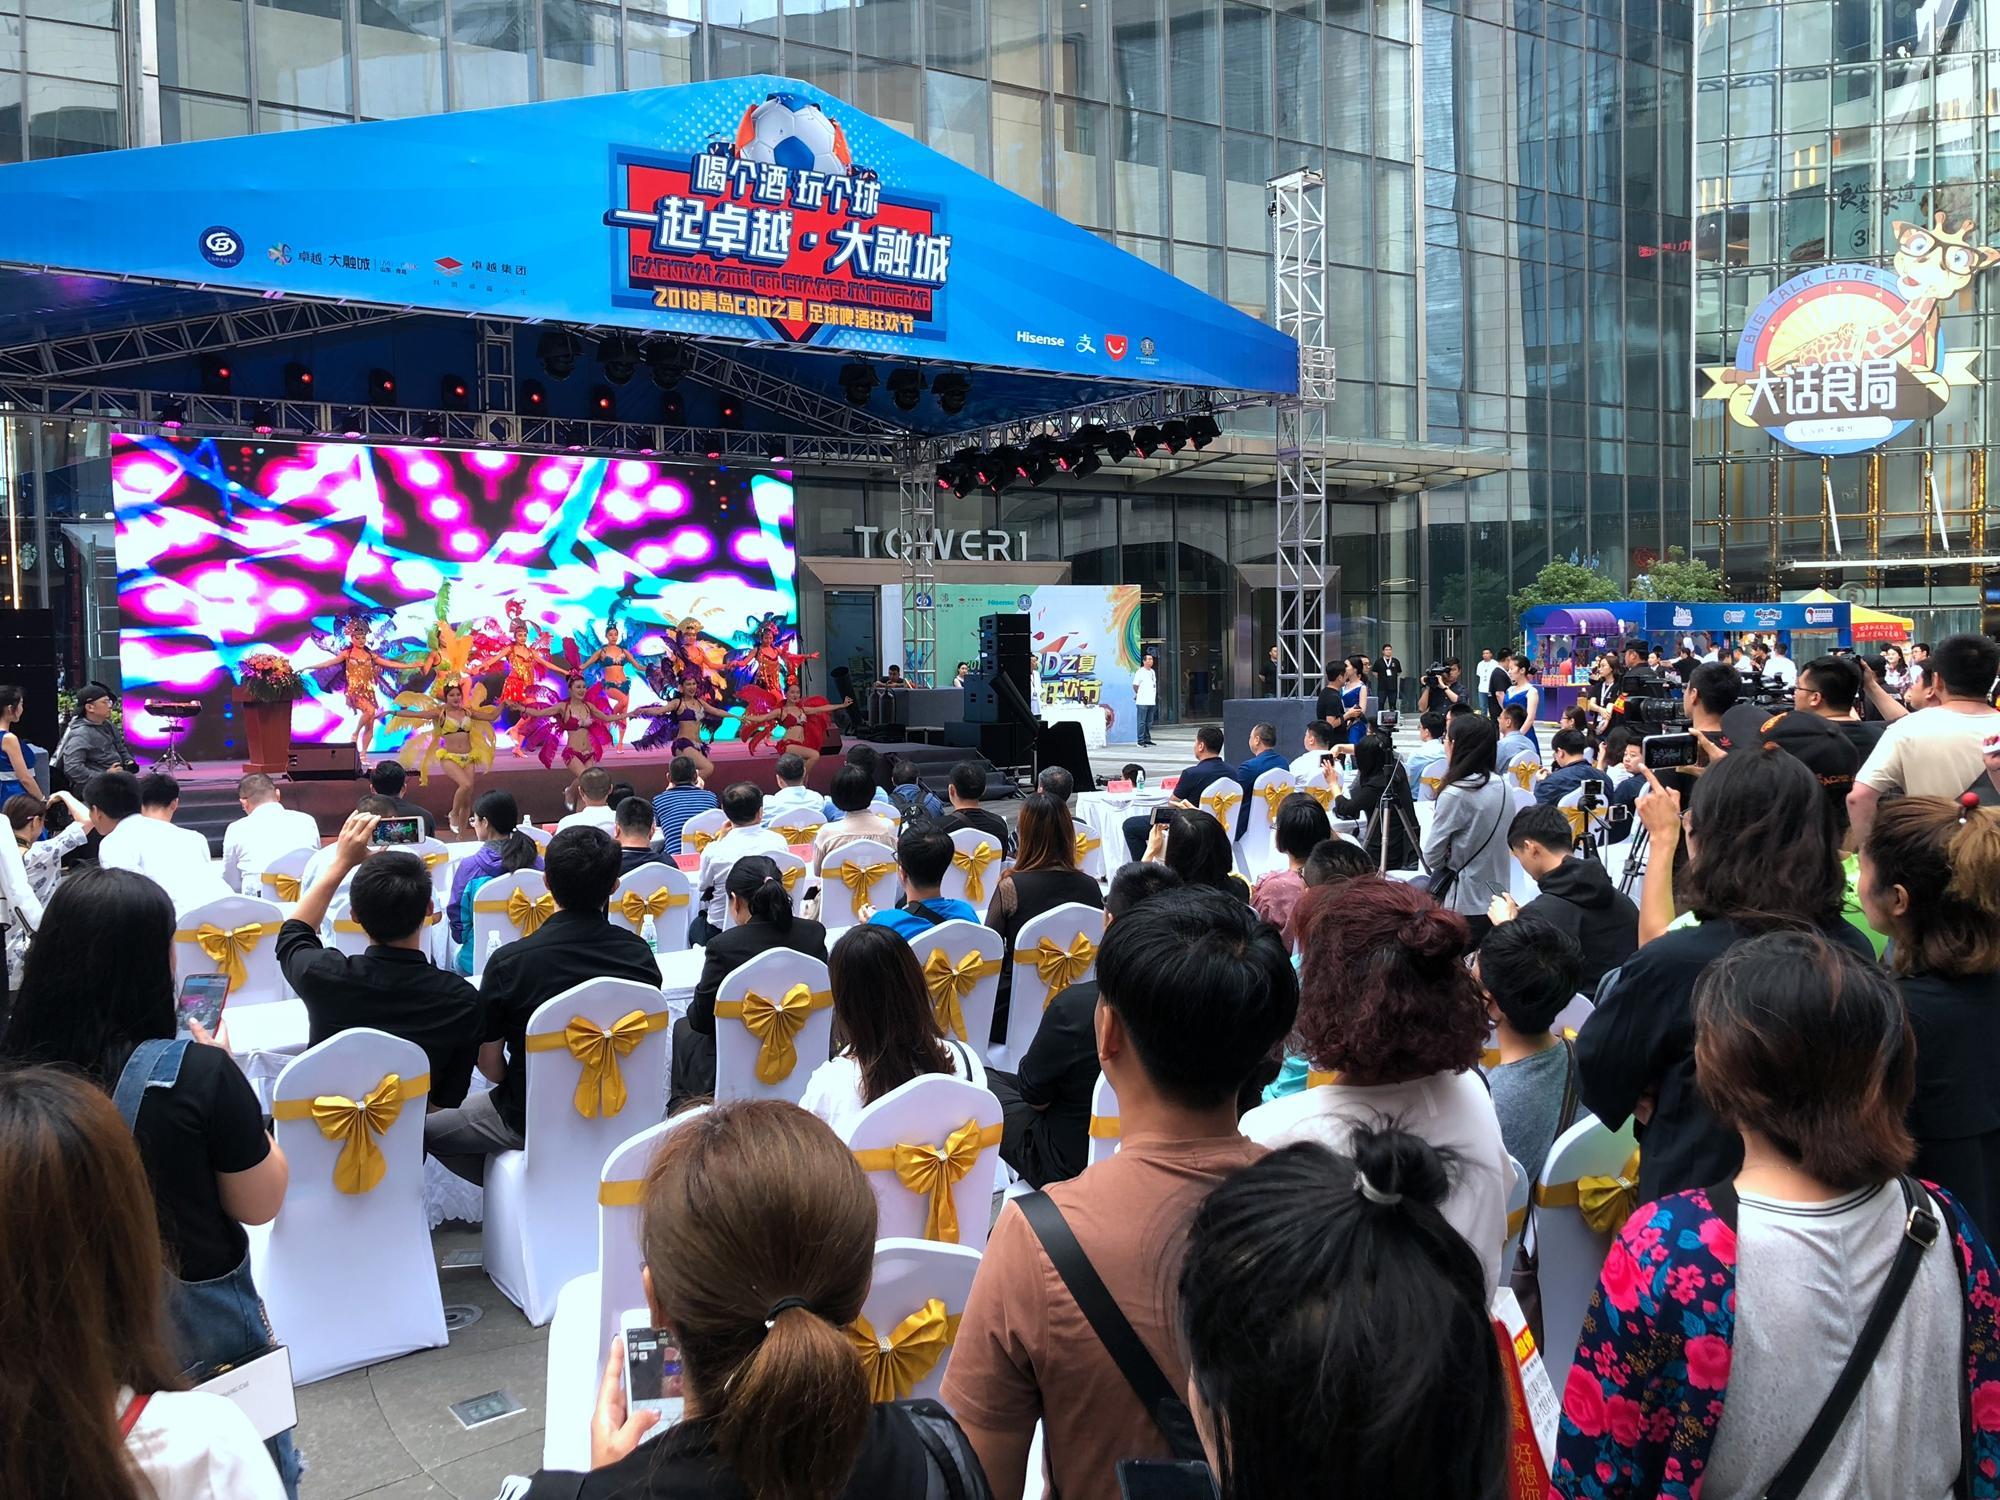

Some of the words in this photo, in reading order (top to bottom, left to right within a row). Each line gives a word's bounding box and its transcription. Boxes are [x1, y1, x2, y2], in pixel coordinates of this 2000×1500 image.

[697, 154, 788, 203] 喝个酒
[796, 169, 881, 216] 玩个球
[471, 260, 527, 276] 卓越集团
[633, 256, 716, 283] CARNIVAL
[717, 267, 752, 286] 2018
[751, 271, 782, 291] CBD
[781, 274, 849, 299] SUMMER
[850, 282, 868, 301] IN
[866, 286, 932, 311] QINGDAO
[653, 286, 805, 322] 2018青岛CBD之夏
[808, 304, 916, 334] 足球啤酒狂欢节
[1743, 313, 1767, 344] BIG
[1767, 275, 1813, 307] TALK
[1825, 267, 1876, 282] CATE
[1016, 331, 1065, 347] Hisense
[1743, 359, 1898, 417] 大话食局
